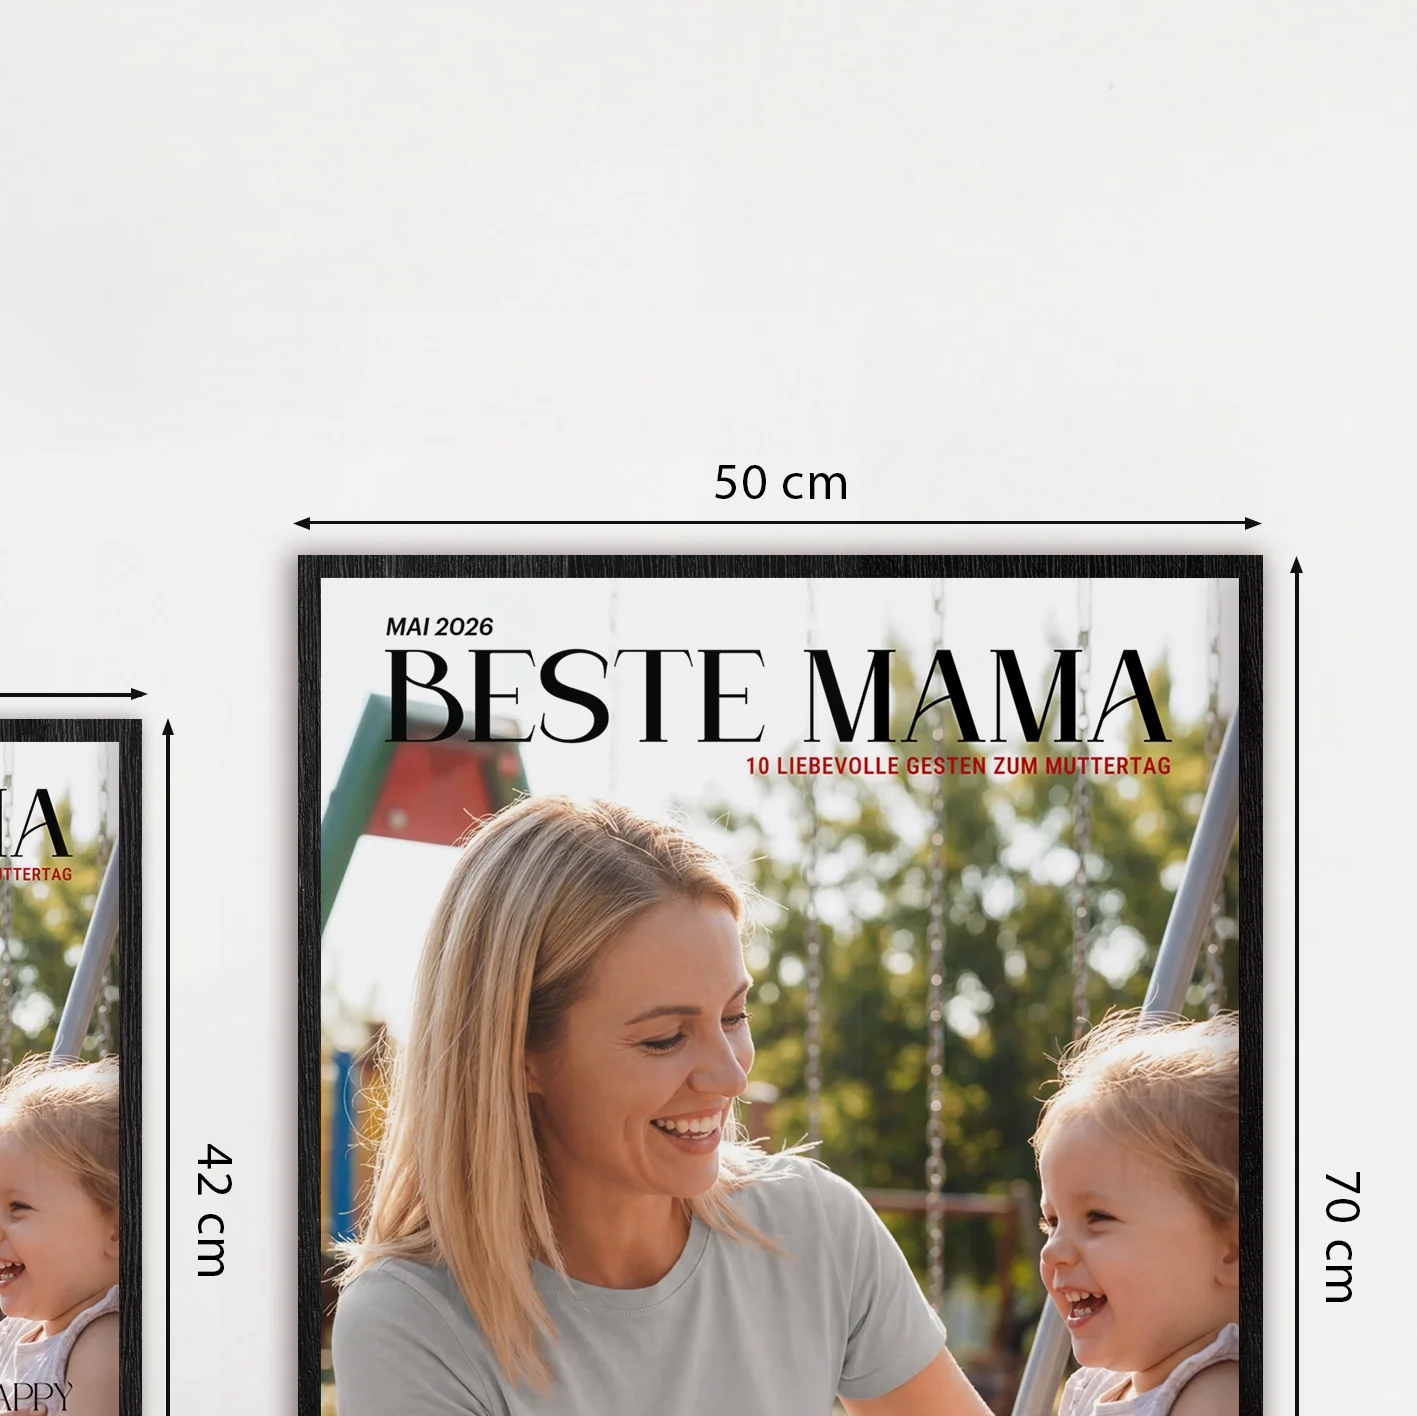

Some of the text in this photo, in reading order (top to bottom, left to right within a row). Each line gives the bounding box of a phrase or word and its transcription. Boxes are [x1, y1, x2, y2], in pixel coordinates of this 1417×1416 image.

[386, 617, 494, 636] MAI 2026
[384, 648, 1173, 744] BESTE MAMA
[746, 756, 1172, 775] 10 LIEBEVOLLE GESTEN ZUM MUTTERTAG
